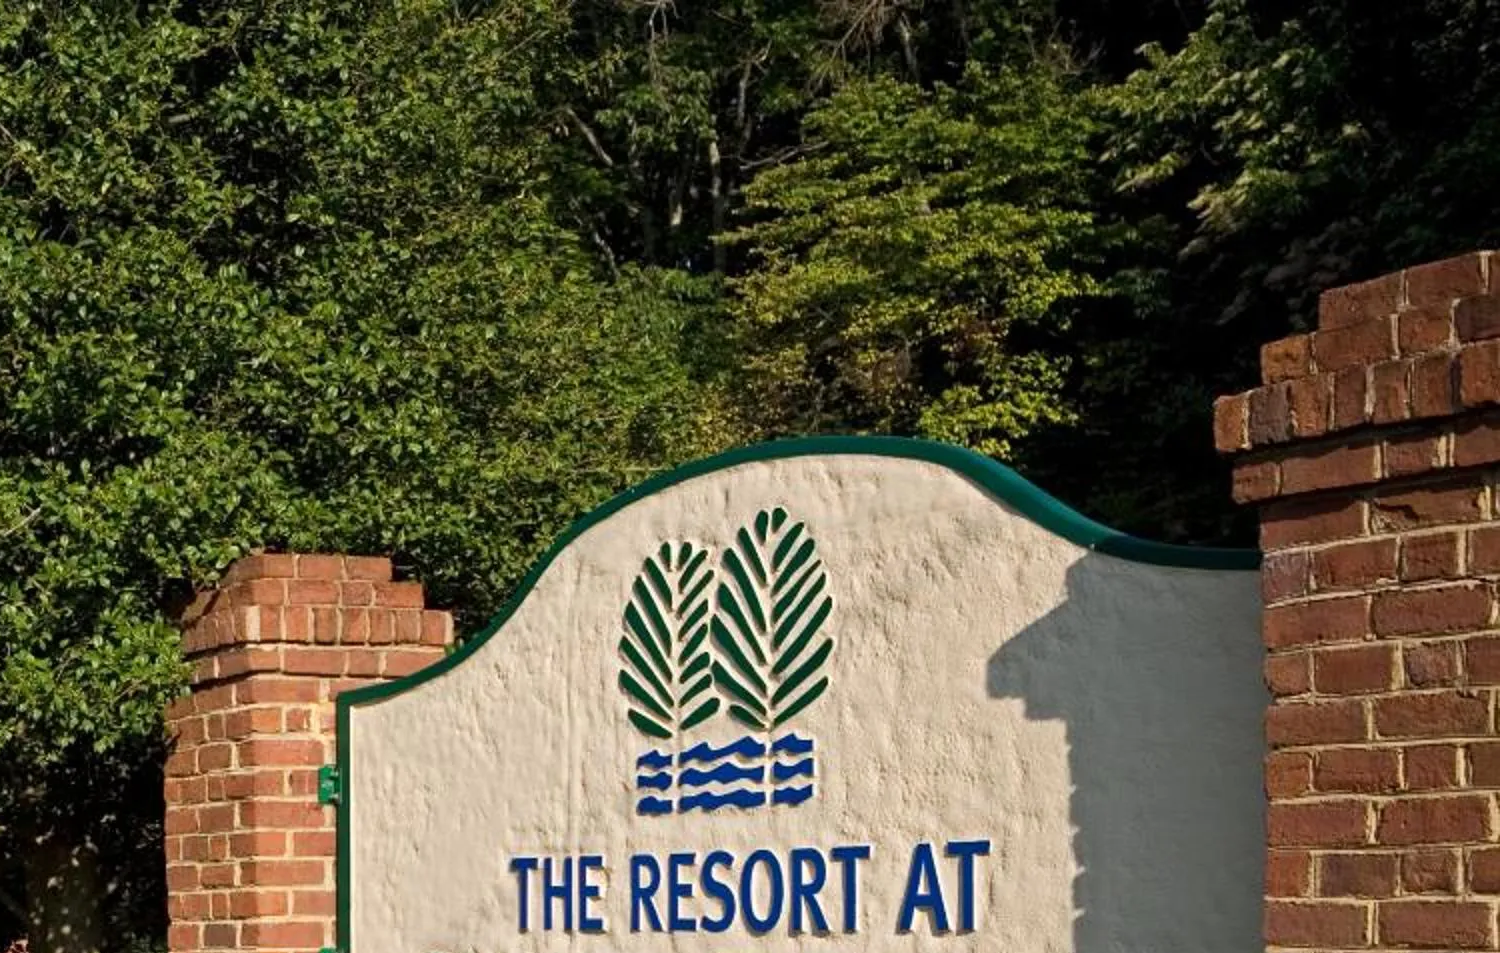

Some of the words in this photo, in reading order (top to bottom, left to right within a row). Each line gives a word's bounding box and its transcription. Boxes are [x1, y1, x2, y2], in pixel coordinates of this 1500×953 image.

[510, 855, 606, 934] THE
[630, 845, 871, 937] RESORT
[900, 840, 991, 934] AT
